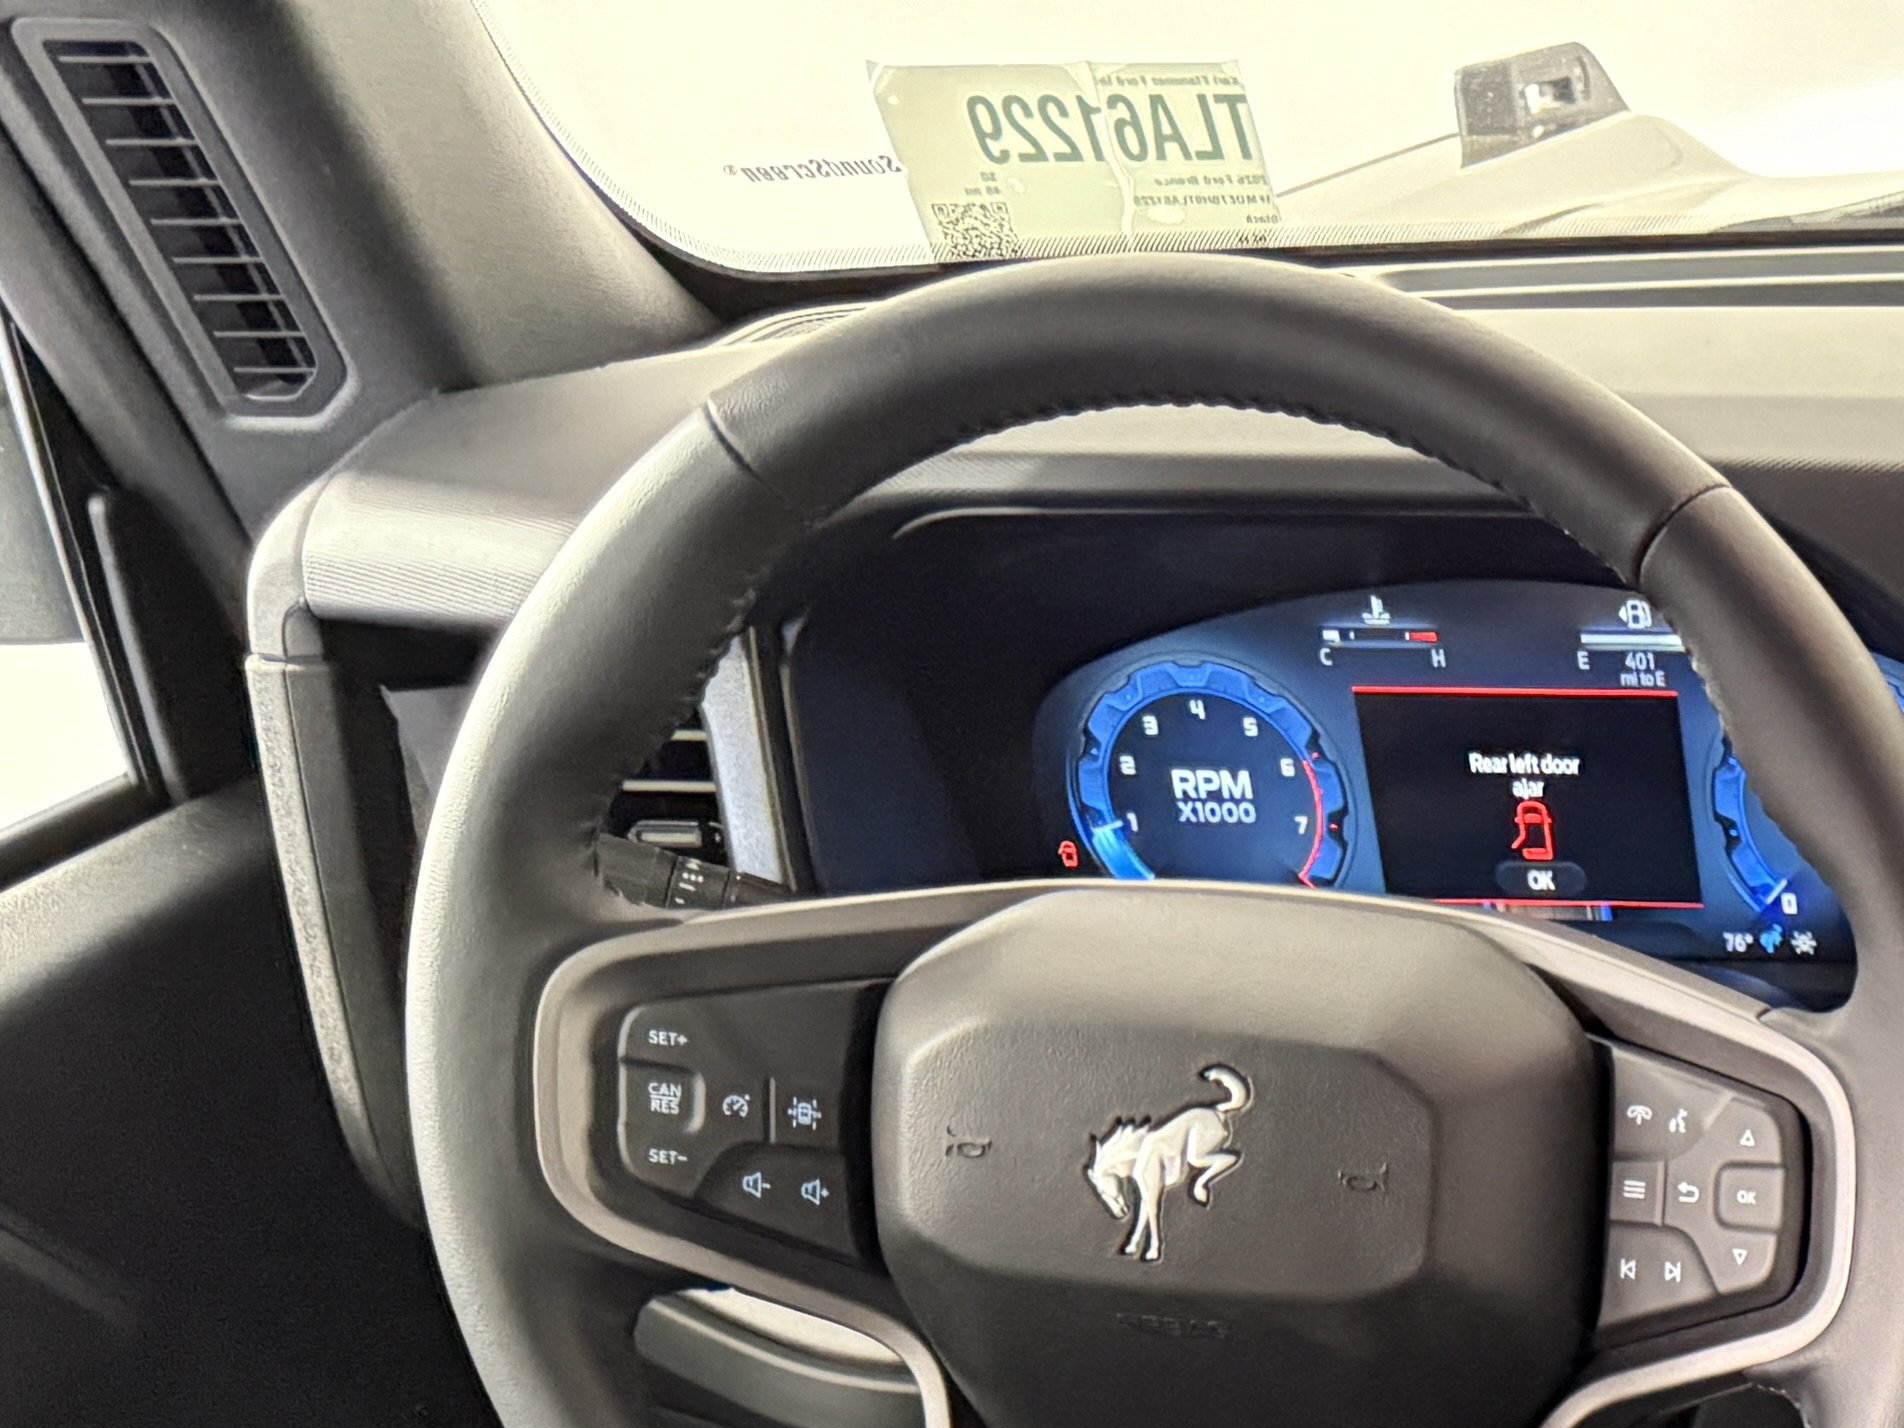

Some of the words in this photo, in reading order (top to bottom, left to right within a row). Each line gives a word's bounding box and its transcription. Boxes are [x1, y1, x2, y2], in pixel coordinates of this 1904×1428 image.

[1319, 648, 1333, 666] C
[1431, 648, 1446, 668] H
[1577, 652, 1590, 670] E
[1625, 652, 1655, 671] 401
[1620, 671, 1638, 687] mi
[1639, 672, 1654, 687] to
[1655, 672, 1666, 687] E
[1189, 700, 1206, 721] 4
[1142, 716, 1159, 736] 3
[1243, 717, 1259, 737] 5
[1119, 756, 1136, 775] 2
[1280, 758, 1295, 777] 6
[1469, 752, 1508, 774] Rear
[1509, 753, 1541, 775] left
[1540, 754, 1581, 776] door
[1172, 769, 1254, 800] RPM
[1512, 778, 1545, 800] ajar
[1178, 801, 1256, 824] X1000
[1126, 813, 1138, 832] 1
[1294, 816, 1308, 835] 7
[1526, 869, 1556, 891] OK
[647, 1029, 688, 1047] SET+
[647, 1082, 683, 1097] CAN
[650, 1099, 680, 1115] RES
[1735, 1190, 1758, 1206] OK
